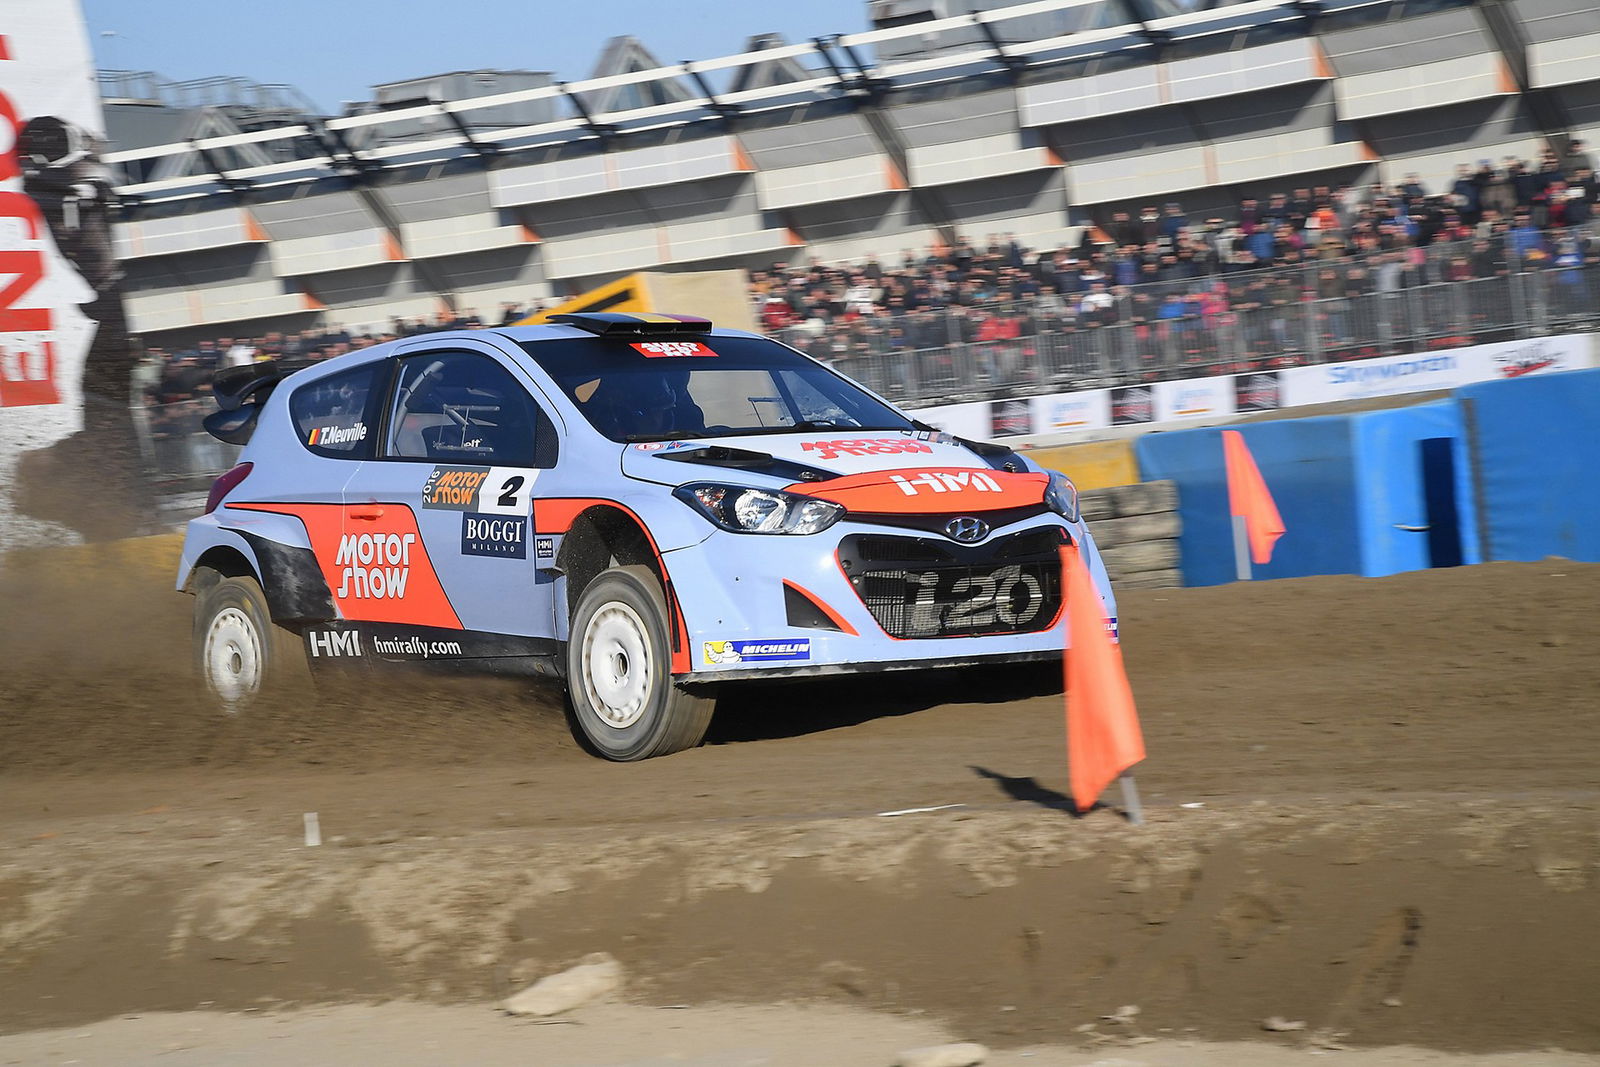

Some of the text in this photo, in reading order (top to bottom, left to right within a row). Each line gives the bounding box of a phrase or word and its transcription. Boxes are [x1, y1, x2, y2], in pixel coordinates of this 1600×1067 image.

[320, 422, 367, 445] T.Neuville
[423, 470, 440, 504] 2016
[497, 475, 525, 507] 2
[889, 471, 1003, 496] HMI
[466, 518, 522, 543] BOGGI
[471, 543, 515, 552] MILANO
[309, 630, 362, 657] HMI
[373, 635, 462, 658] hmirally.com
[741, 643, 810, 654] MICHELIN
